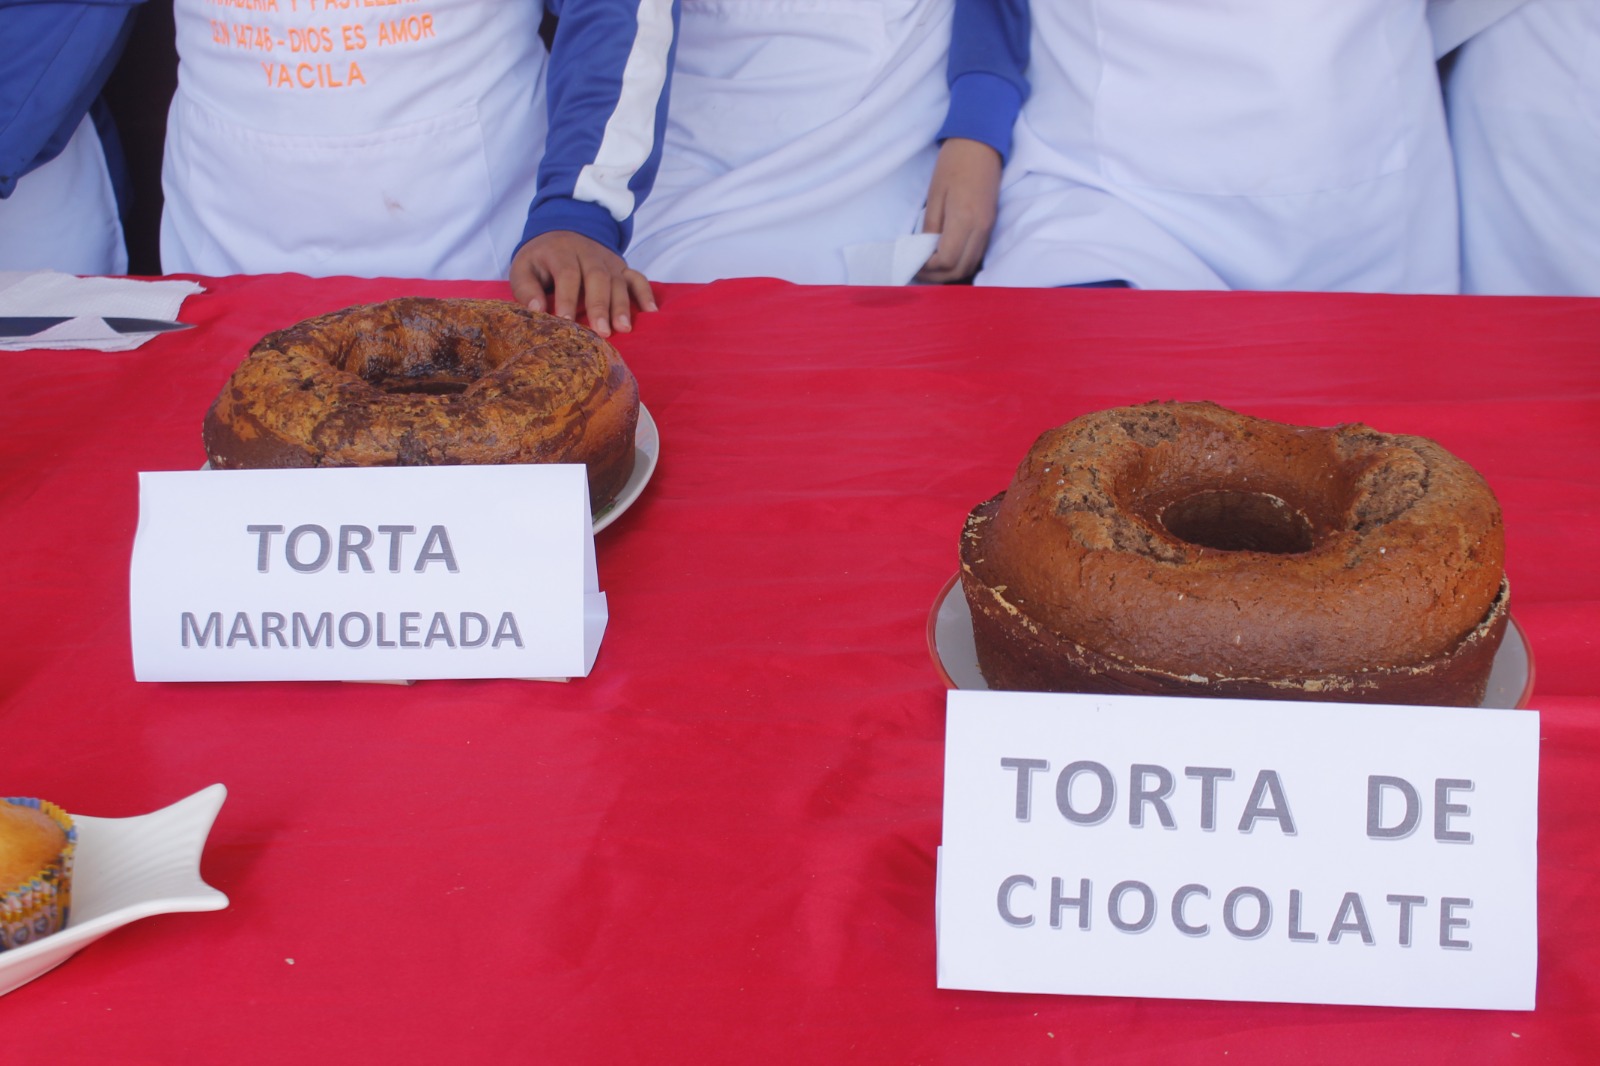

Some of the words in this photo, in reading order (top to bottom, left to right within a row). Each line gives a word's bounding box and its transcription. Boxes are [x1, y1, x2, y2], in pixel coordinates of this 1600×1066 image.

[341, 24, 367, 51] ES
[378, 12, 436, 47] AMOR
[261, 61, 366, 89] YACILA
[246, 524, 460, 575] TORTA
[181, 610, 525, 649] MARMOLEADA
[1000, 756, 1298, 836] TORTA
[1365, 774, 1475, 845] DE
[996, 873, 1474, 952] CHOCOLATE
